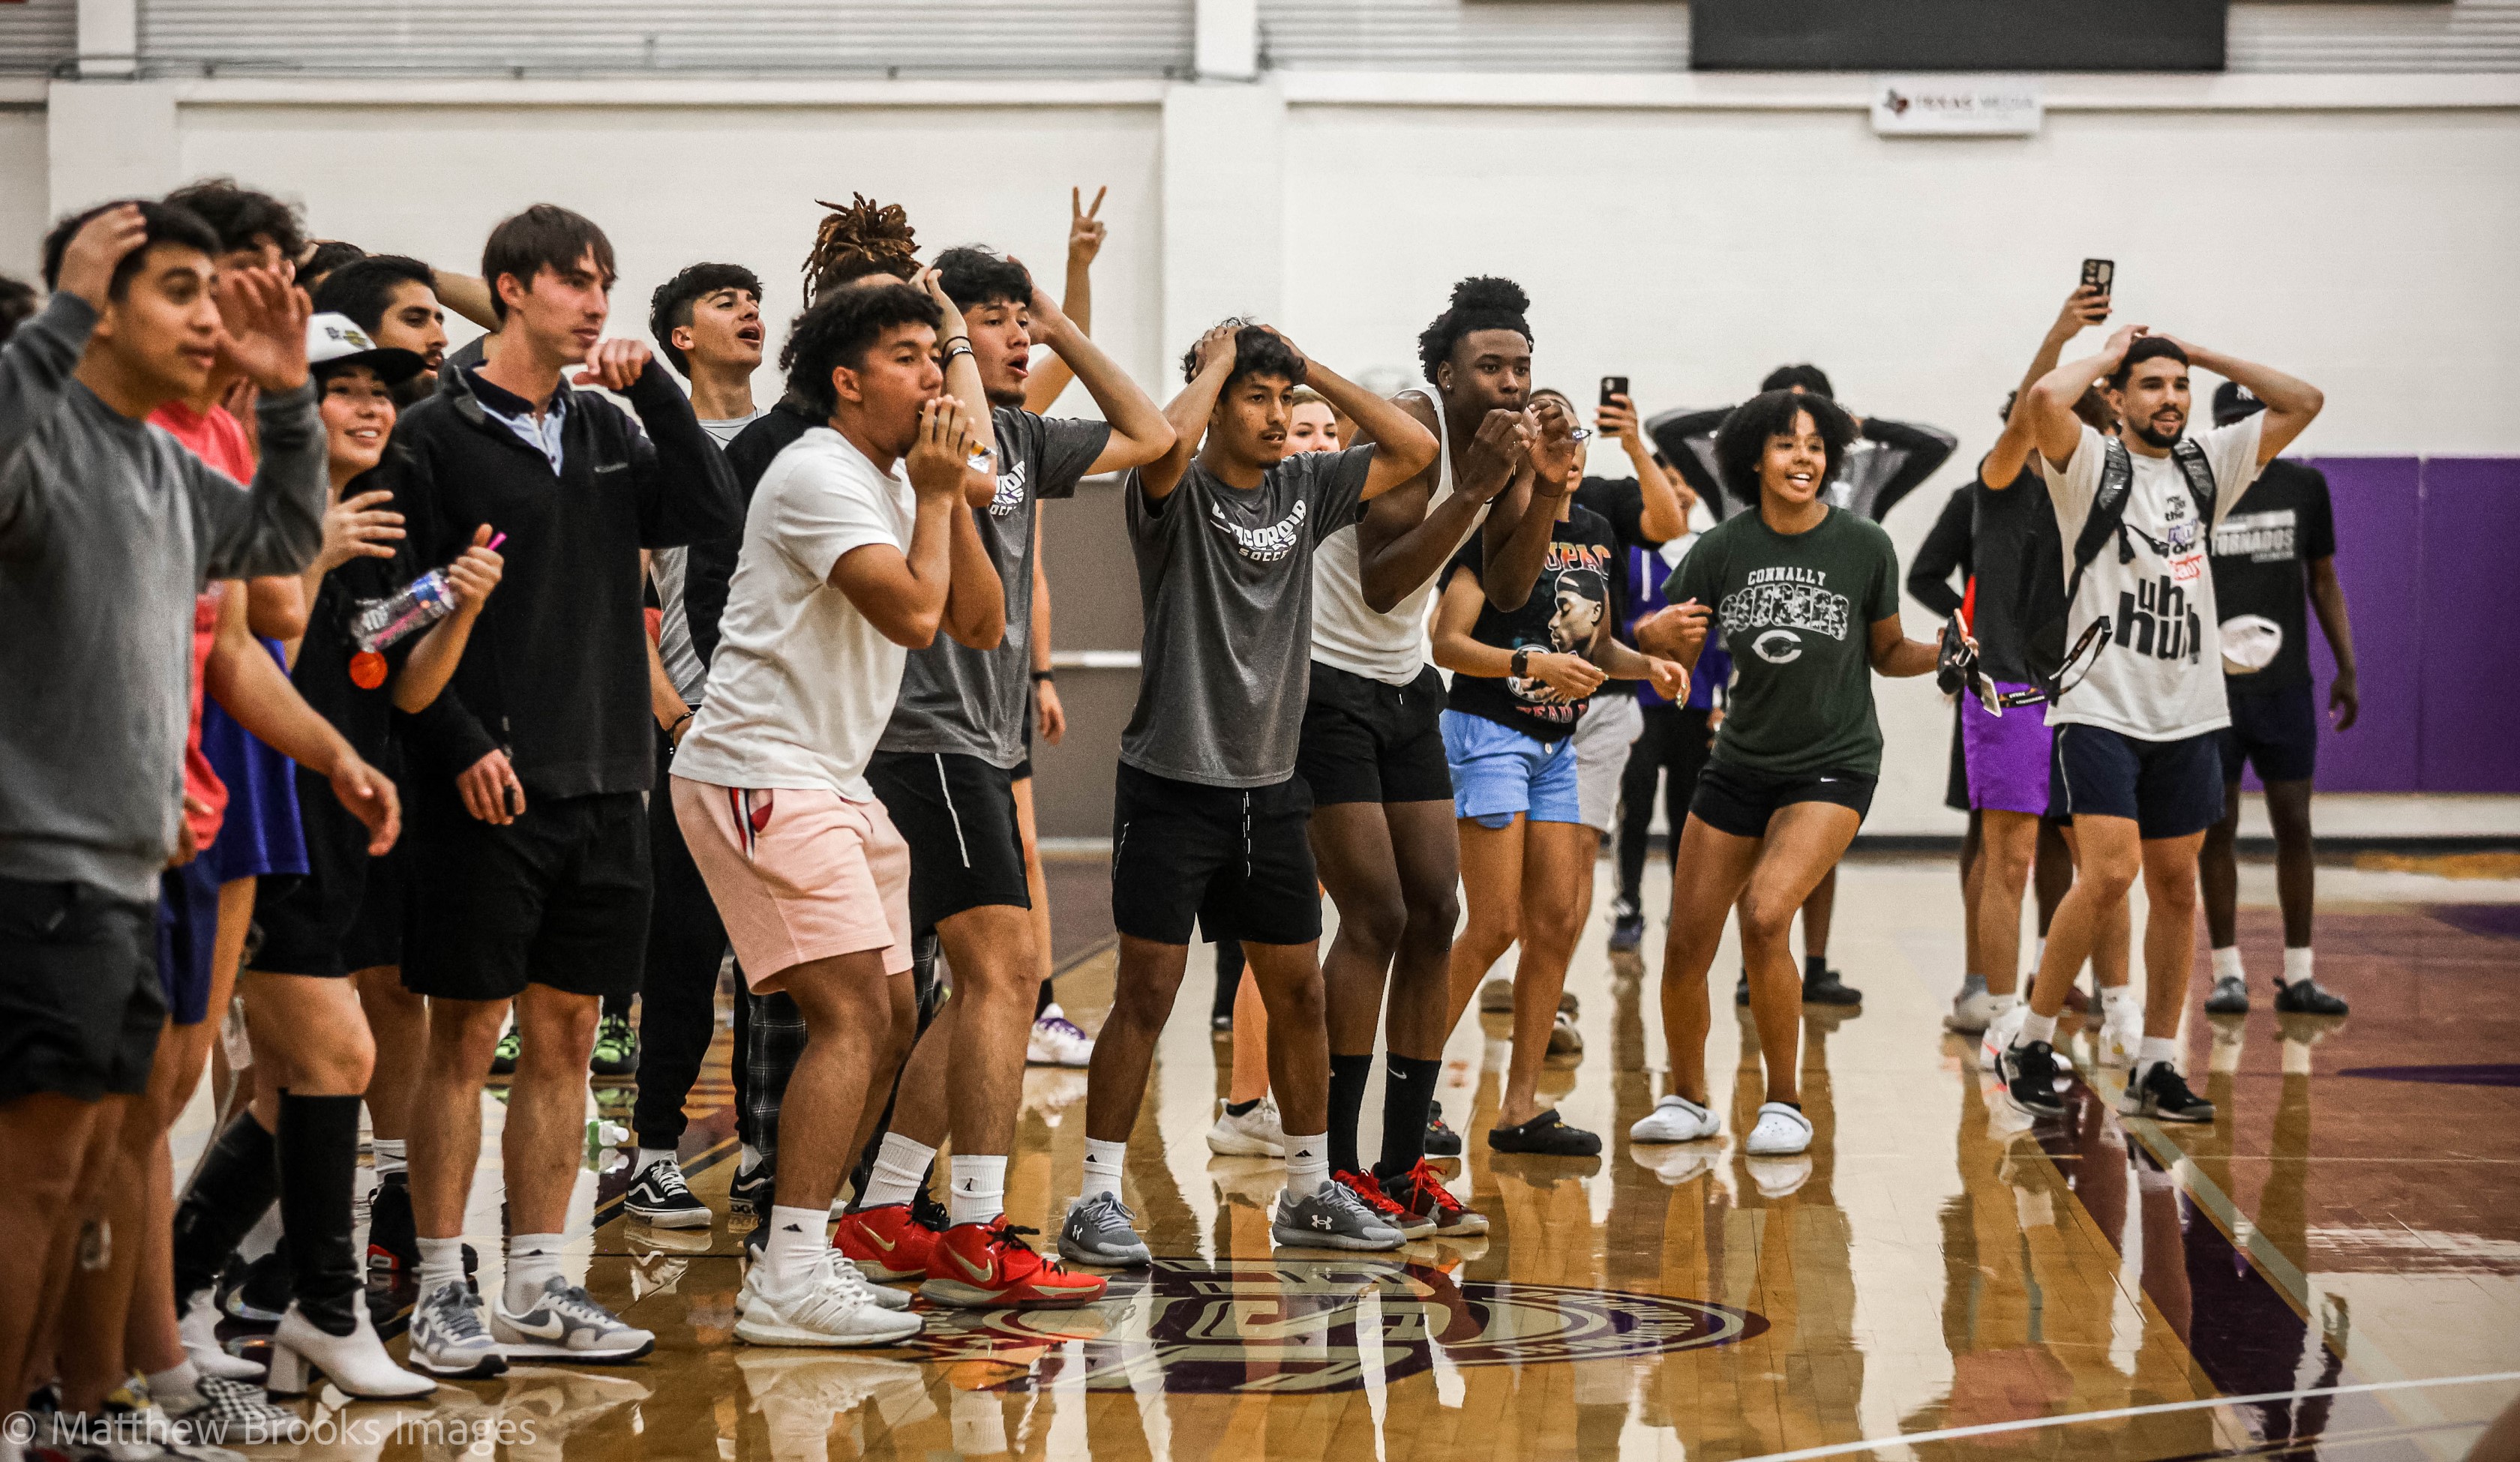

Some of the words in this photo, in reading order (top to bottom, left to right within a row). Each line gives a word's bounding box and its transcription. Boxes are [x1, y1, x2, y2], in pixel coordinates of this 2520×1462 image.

[1545, 541, 1612, 577] UPAC
[1748, 567, 1826, 586] CONNALLY
[2138, 575, 2183, 616] uh
[2115, 591, 2200, 664] huh
